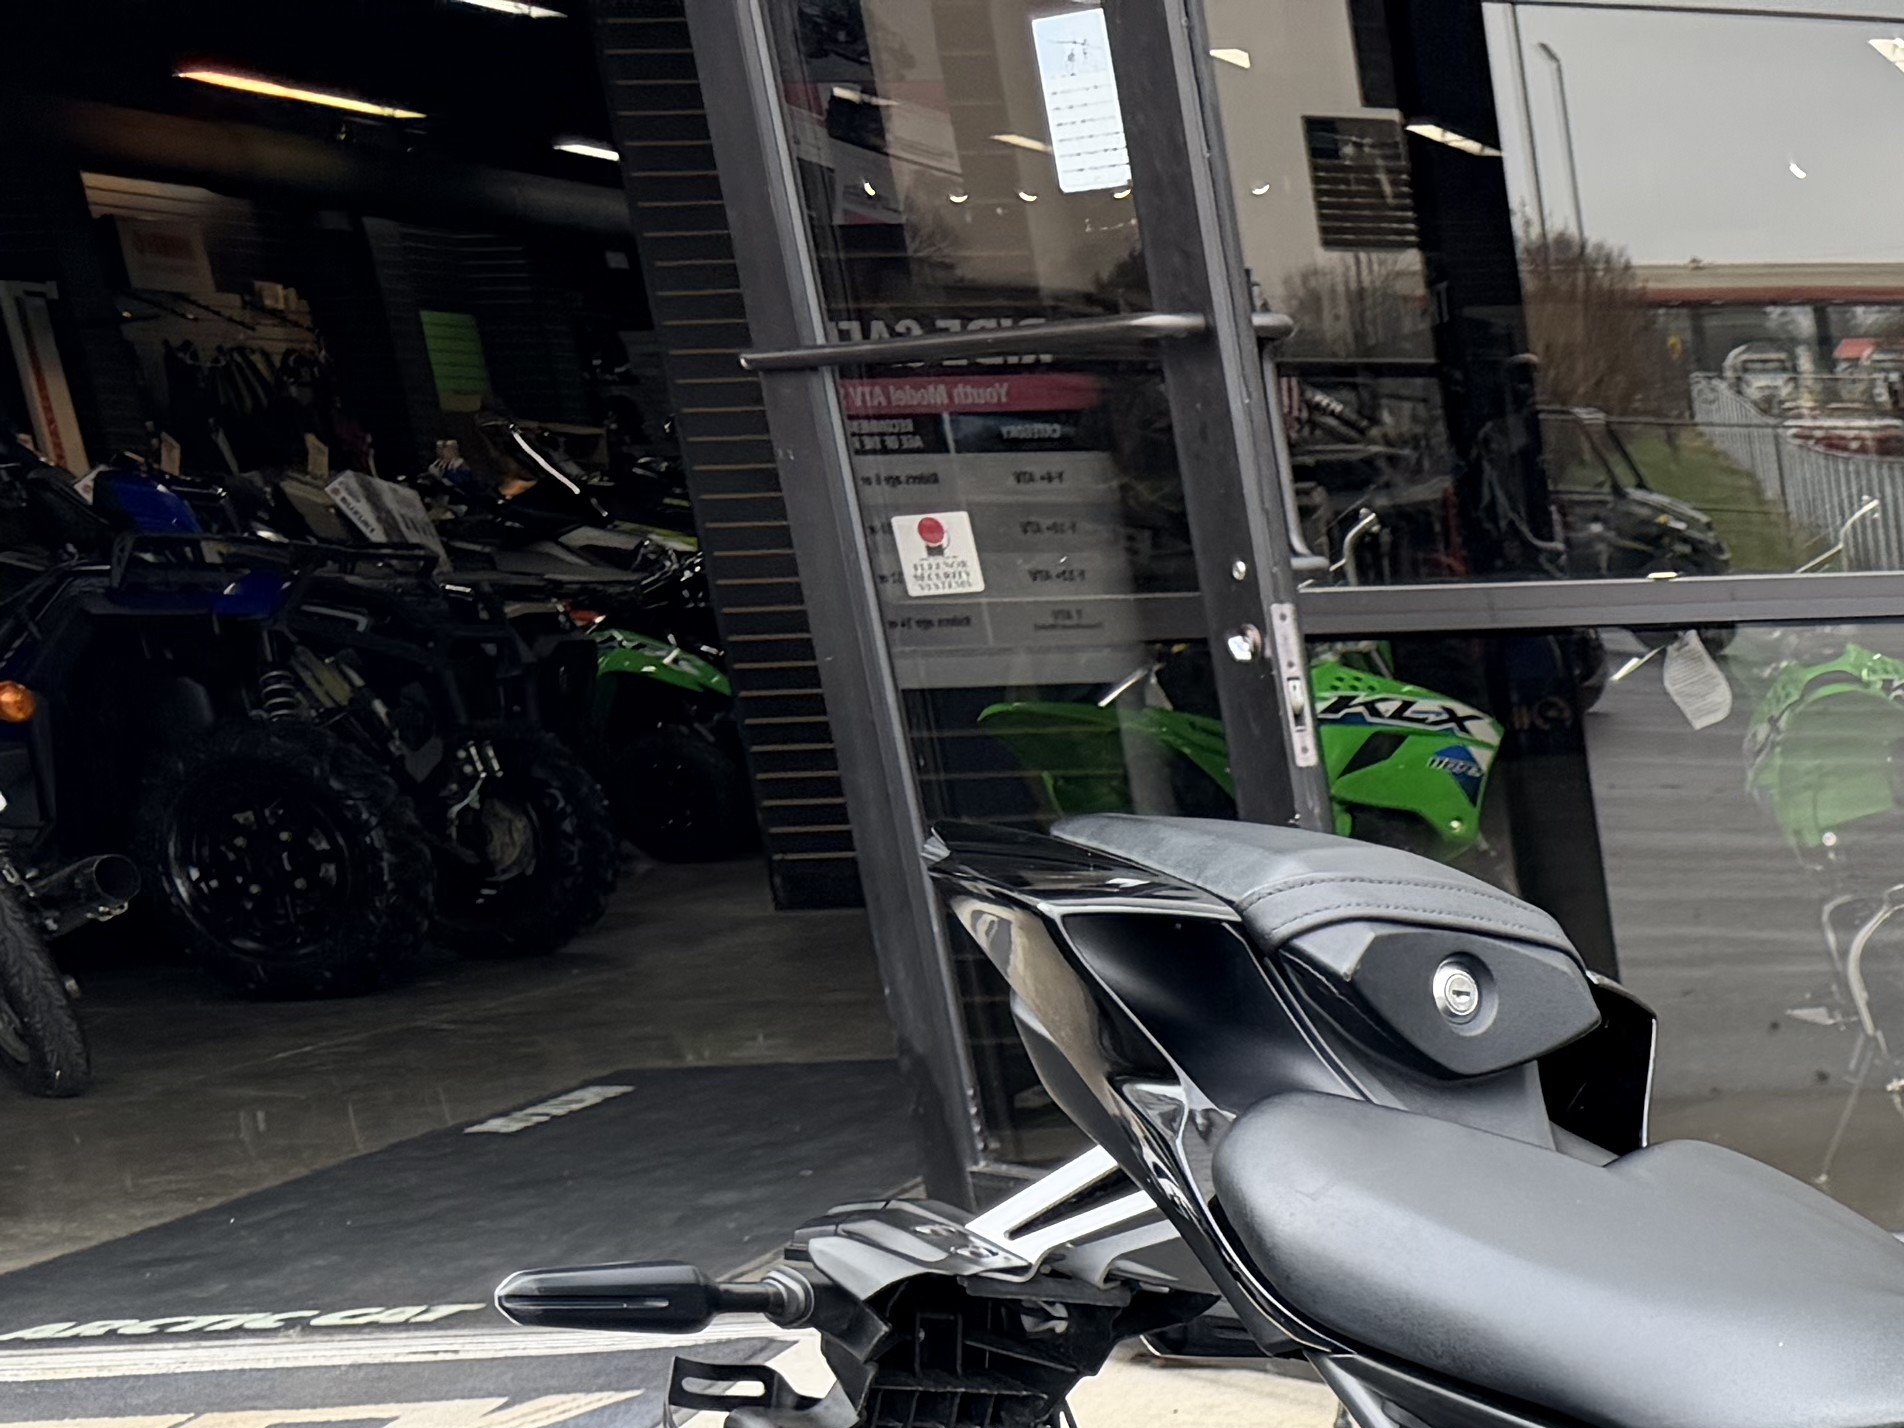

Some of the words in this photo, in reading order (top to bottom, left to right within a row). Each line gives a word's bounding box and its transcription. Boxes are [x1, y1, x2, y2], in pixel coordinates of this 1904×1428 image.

[1317, 694, 1485, 738] KLX
[0, 1310, 319, 1340] ARCTIC
[309, 1302, 487, 1327] CAT
